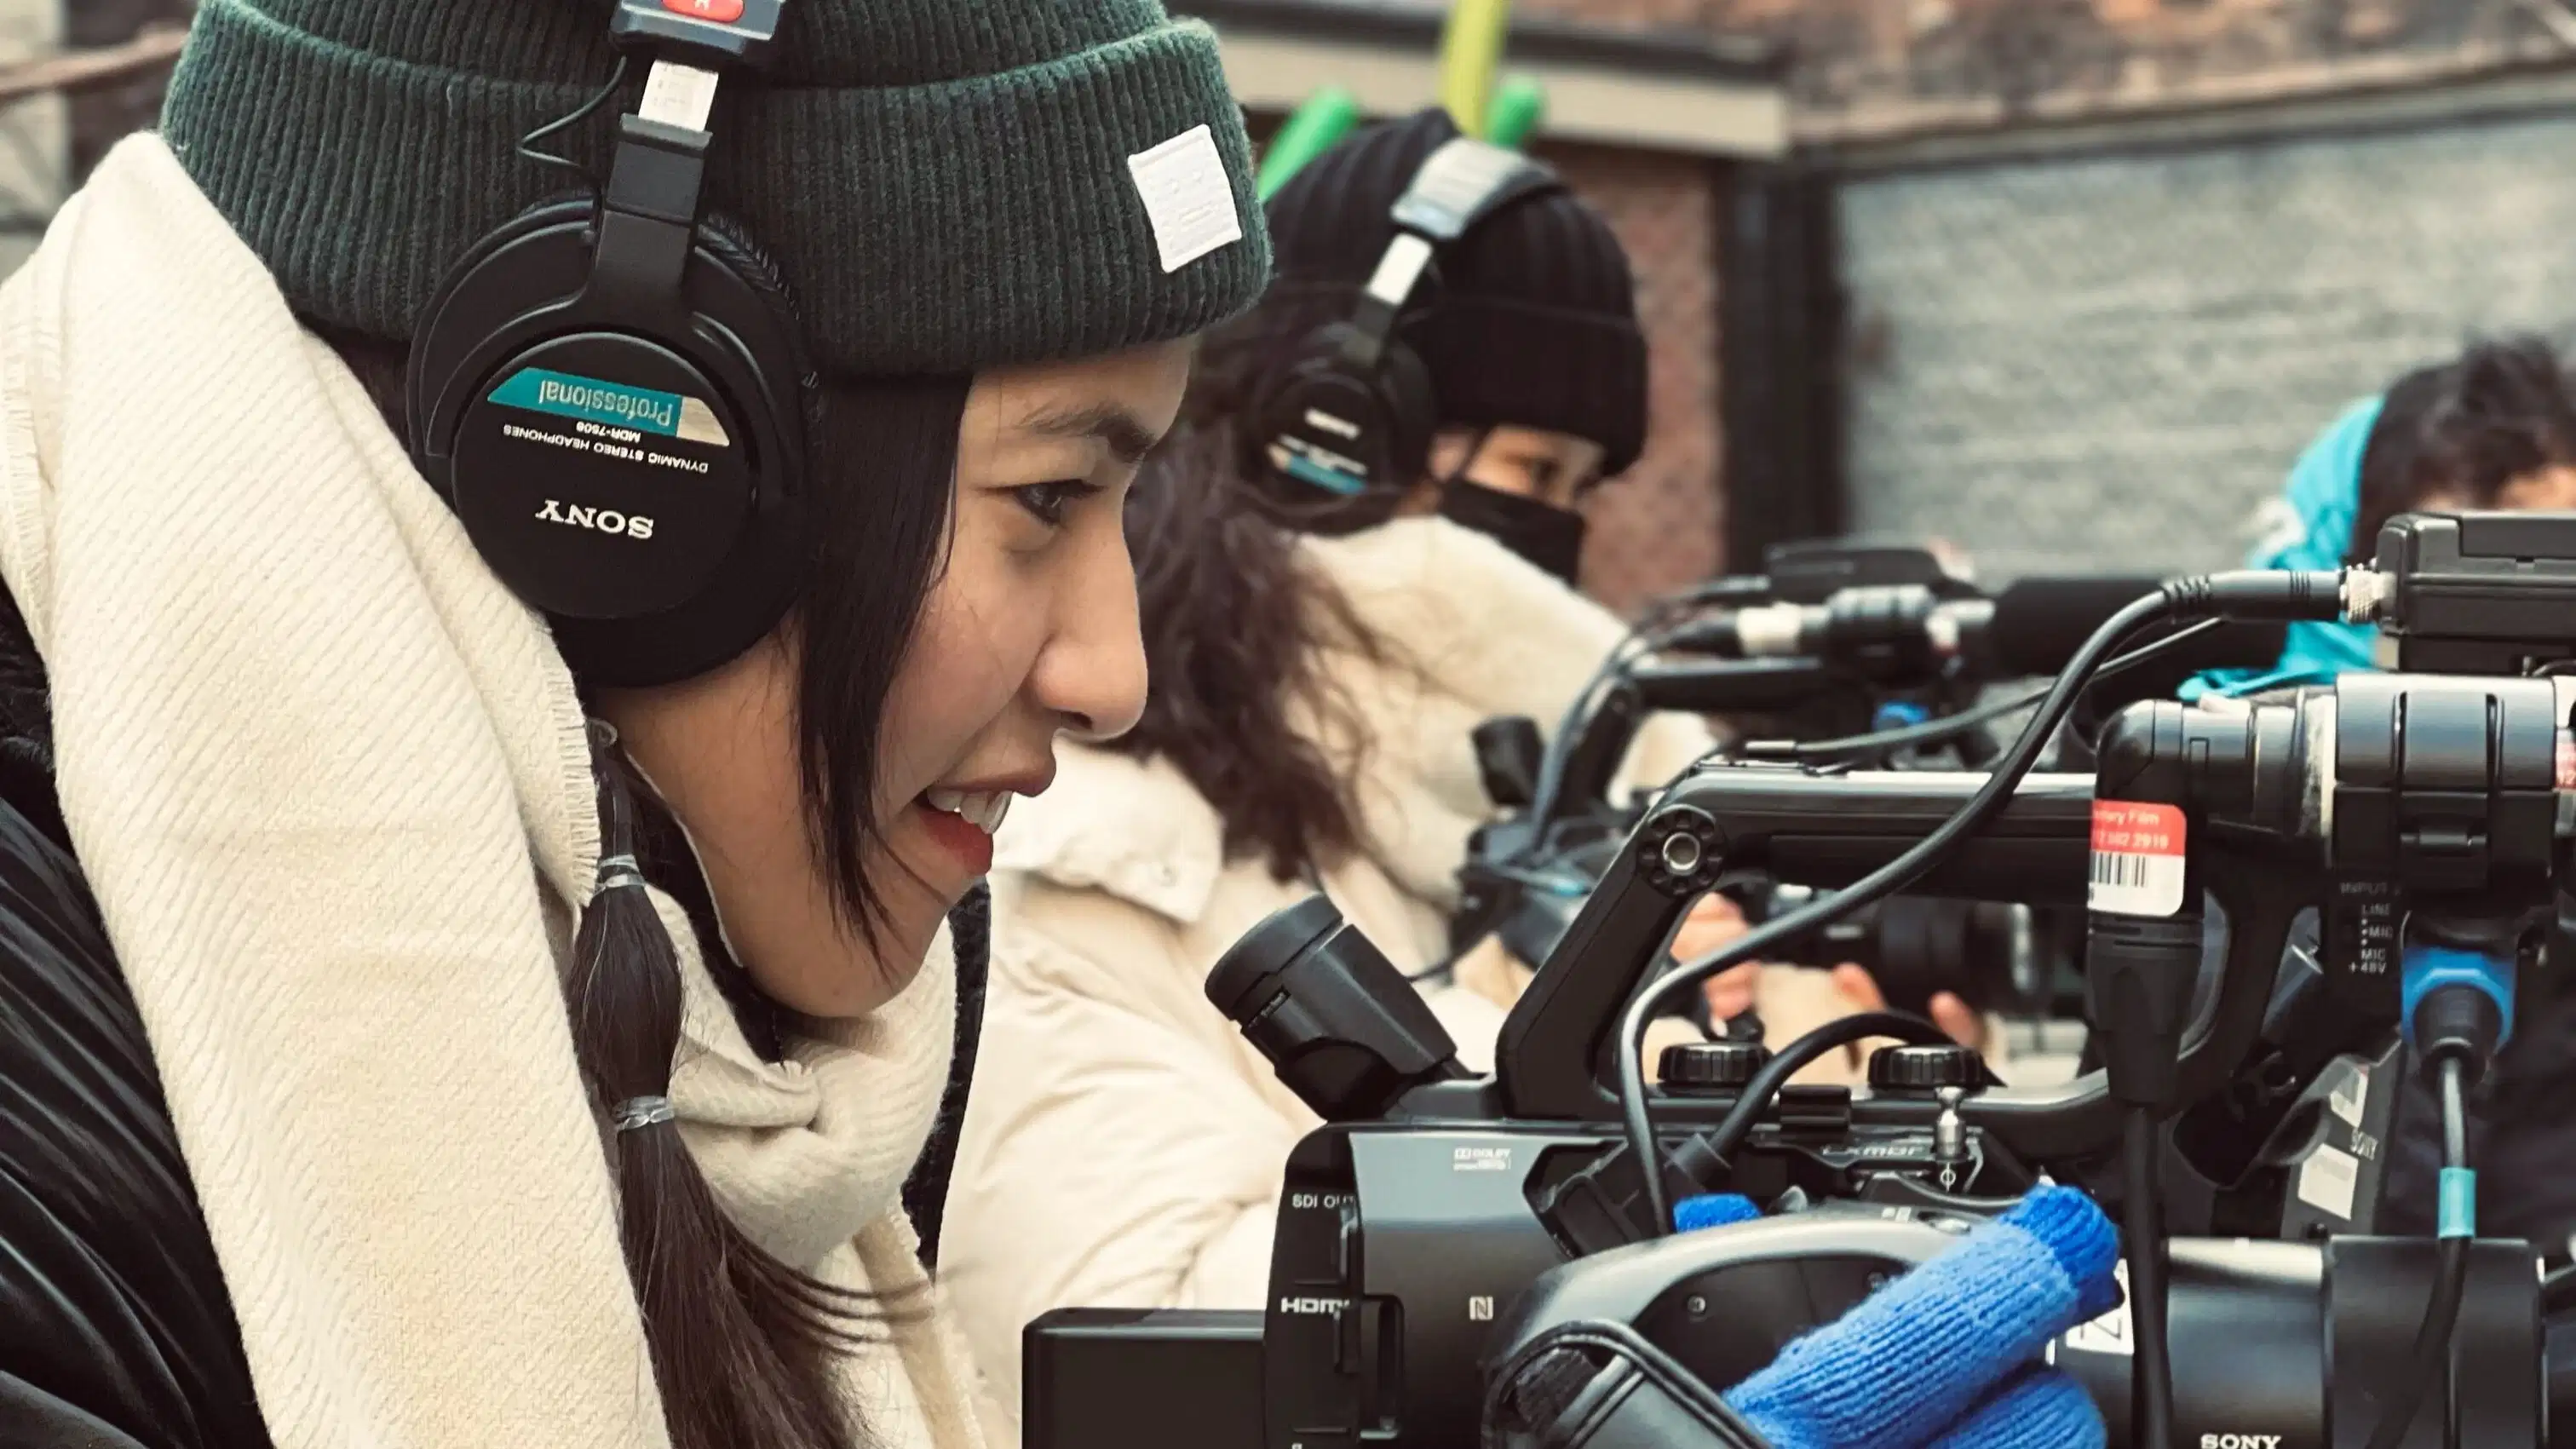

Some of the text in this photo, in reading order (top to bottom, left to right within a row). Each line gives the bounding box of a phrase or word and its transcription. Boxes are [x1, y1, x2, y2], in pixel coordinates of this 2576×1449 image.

[538, 380, 673, 427] Professional
[503, 424, 709, 474] DYNAMIC STEREO HEADPHONES
[535, 498, 654, 539] SONY
[2360, 948, 2386, 961] MIC
[1292, 1193, 1318, 1209] SDI
[2200, 1434, 2282, 1449] SONY
